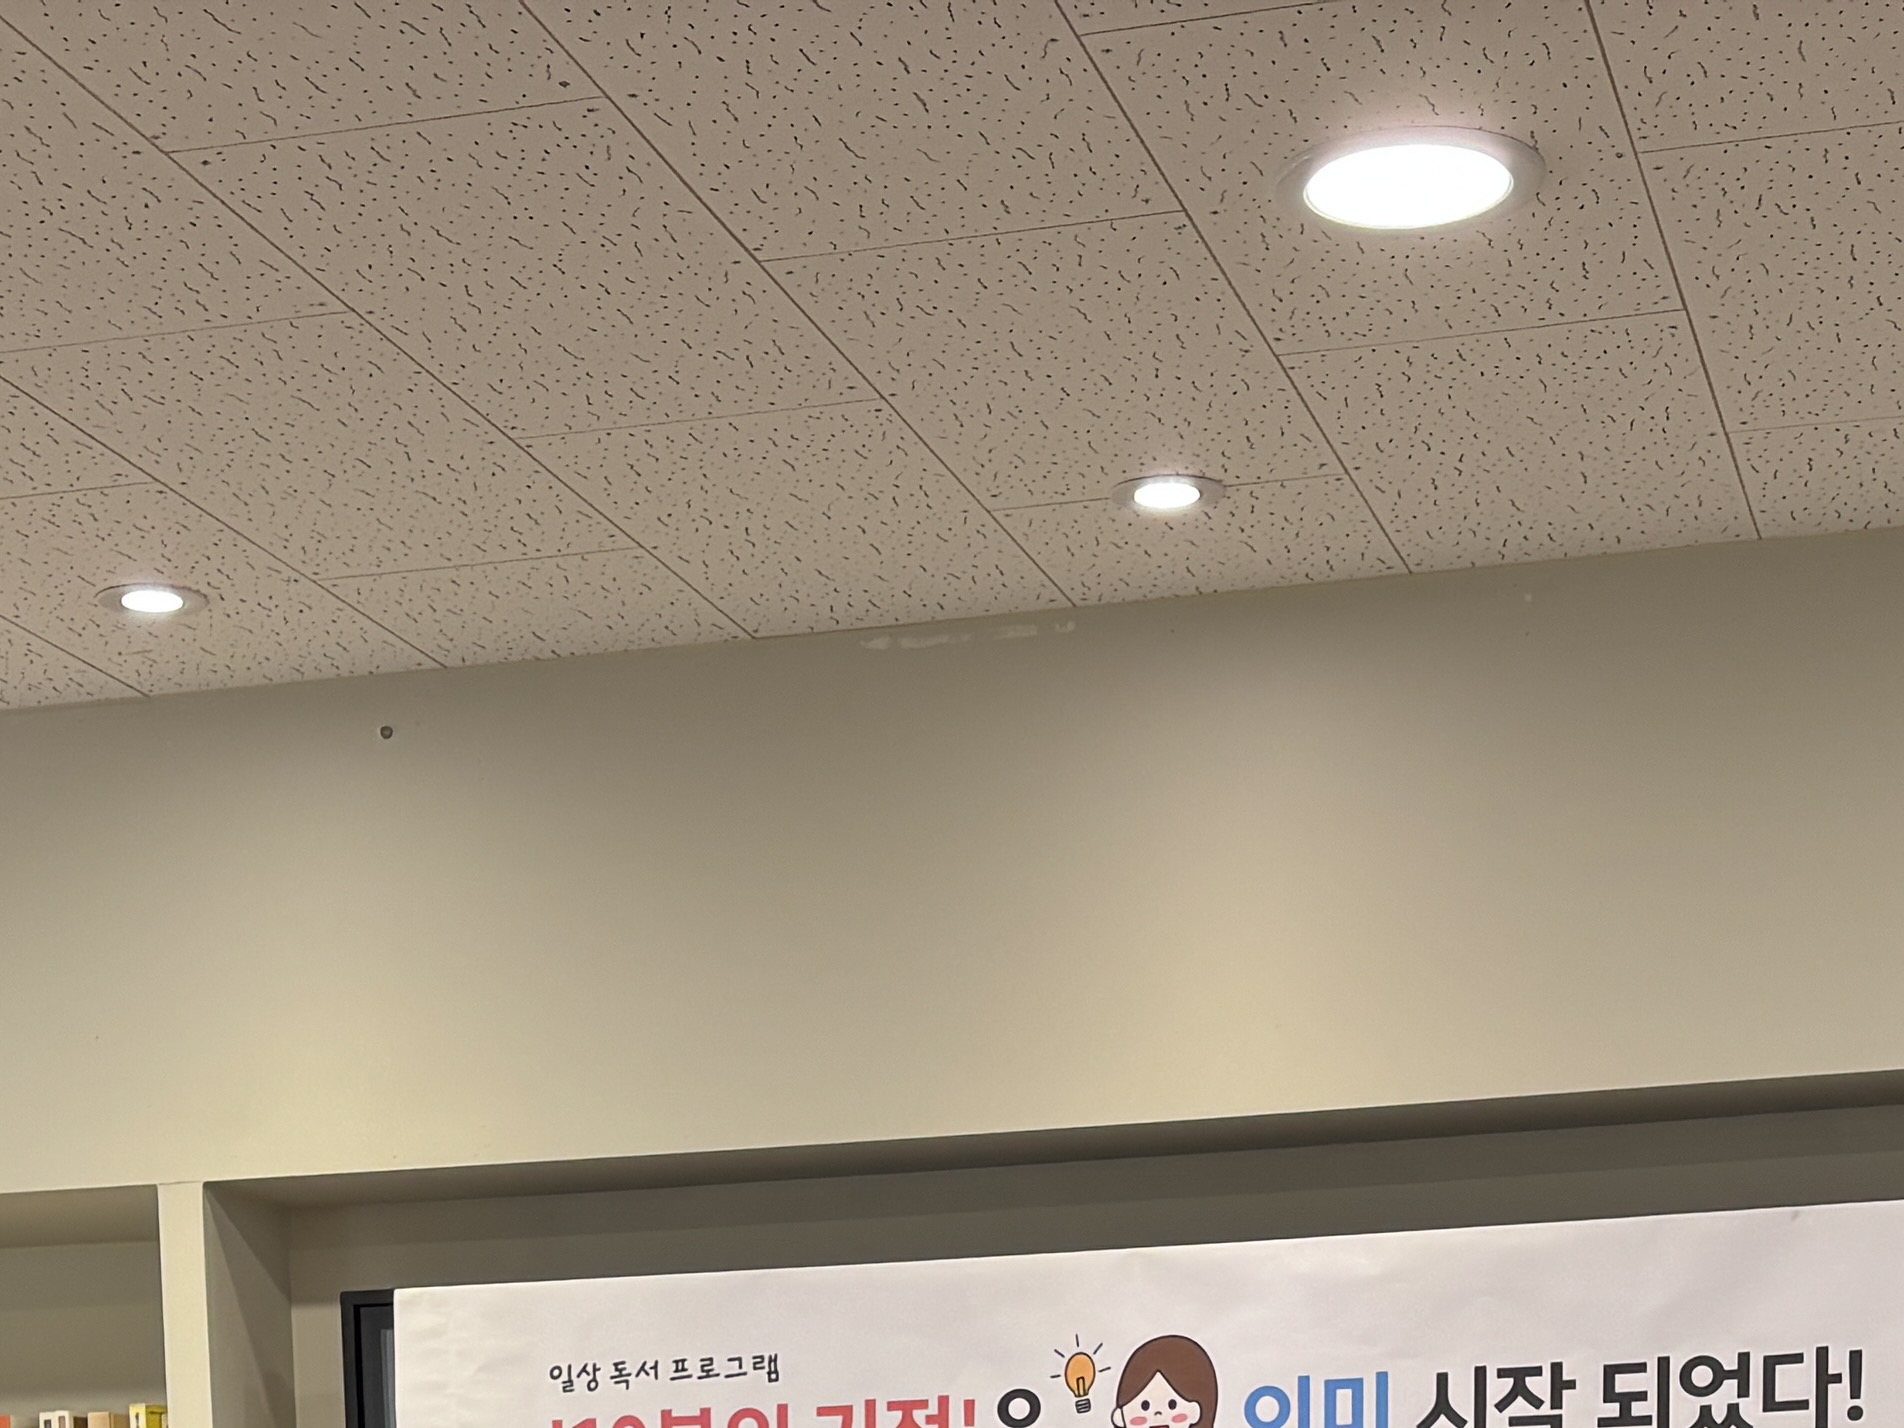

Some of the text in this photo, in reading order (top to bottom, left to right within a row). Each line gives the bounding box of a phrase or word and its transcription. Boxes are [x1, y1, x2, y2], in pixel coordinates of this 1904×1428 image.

[549, 1352, 781, 1393] 일상 독서 프로그램
